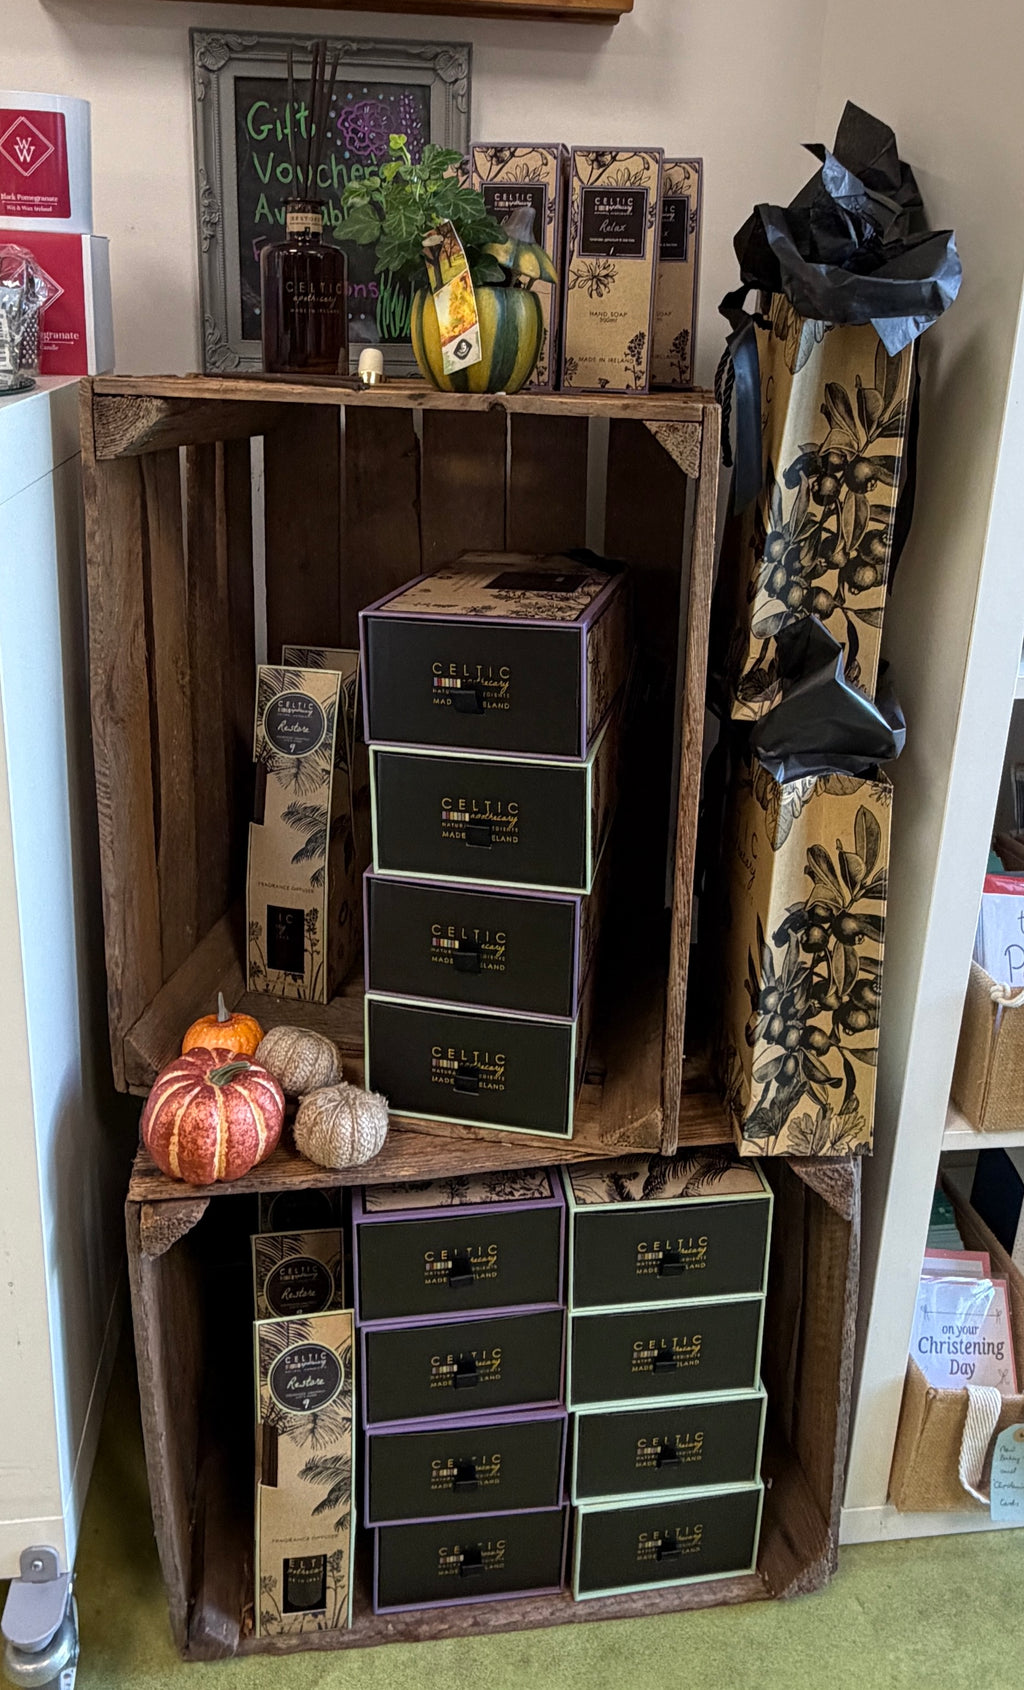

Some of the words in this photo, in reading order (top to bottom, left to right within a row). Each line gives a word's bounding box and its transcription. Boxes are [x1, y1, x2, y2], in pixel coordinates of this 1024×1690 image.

[494, 192, 533, 201] CELTIC
[594, 197, 634, 206] CELTIC
[600, 219, 627, 233] Relax
[286, 281, 342, 295] CELTIC
[432, 662, 510, 680] CELTIC
[277, 700, 314, 710] CELTIC
[277, 720, 311, 733] Restore
[441, 797, 519, 815] CELTIC
[442, 831, 466, 839] MADE
[431, 924, 506, 944] CELTIC
[432, 956, 454, 964] MADE
[431, 1046, 506, 1065] CELTIC
[432, 1076, 455, 1084] MADE
[637, 1236, 708, 1252] CELTIC
[280, 1265, 318, 1275] CELTIC
[281, 1287, 316, 1299] Restore
[941, 1325, 955, 1335] on
[956, 1325, 979, 1338] your
[633, 1335, 702, 1350] CELTIC
[918, 1336, 1005, 1360] Christening
[285, 1352, 327, 1364] CELTIC
[949, 1359, 976, 1380] Day
[287, 1376, 325, 1390] Restore
[637, 1432, 704, 1447] CELTIC
[638, 1524, 703, 1541] CELTIC
